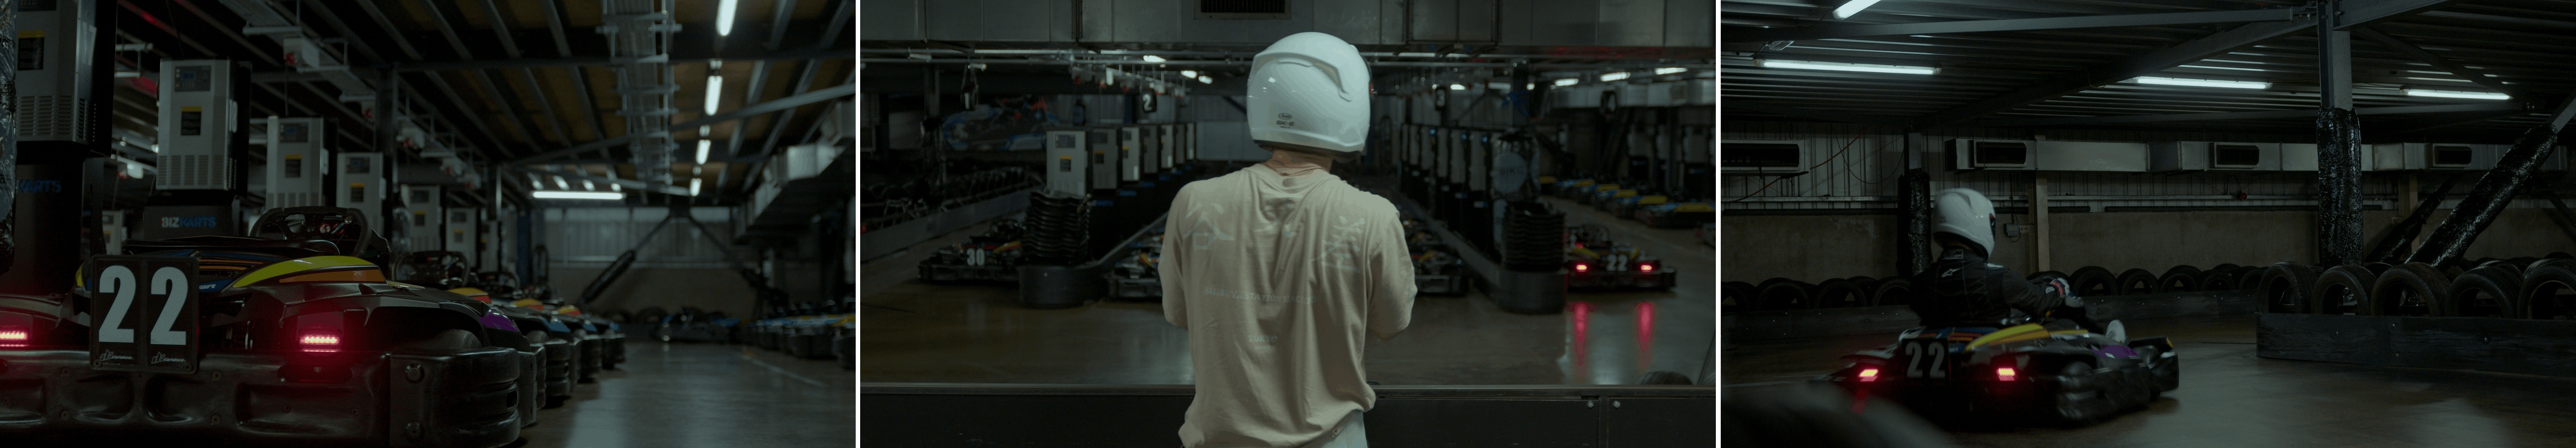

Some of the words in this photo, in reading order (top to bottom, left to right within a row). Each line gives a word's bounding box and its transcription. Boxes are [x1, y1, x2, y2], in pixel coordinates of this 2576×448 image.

[1143, 94, 1153, 111] 2
[161, 216, 216, 228] BIZKARTS
[967, 248, 985, 266] 30
[1606, 253, 1628, 272] 22
[1204, 286, 1243, 299] SHIBUYA
[1245, 293, 1281, 303] STATION
[98, 265, 189, 346] 22
[1905, 341, 1946, 379] 22
